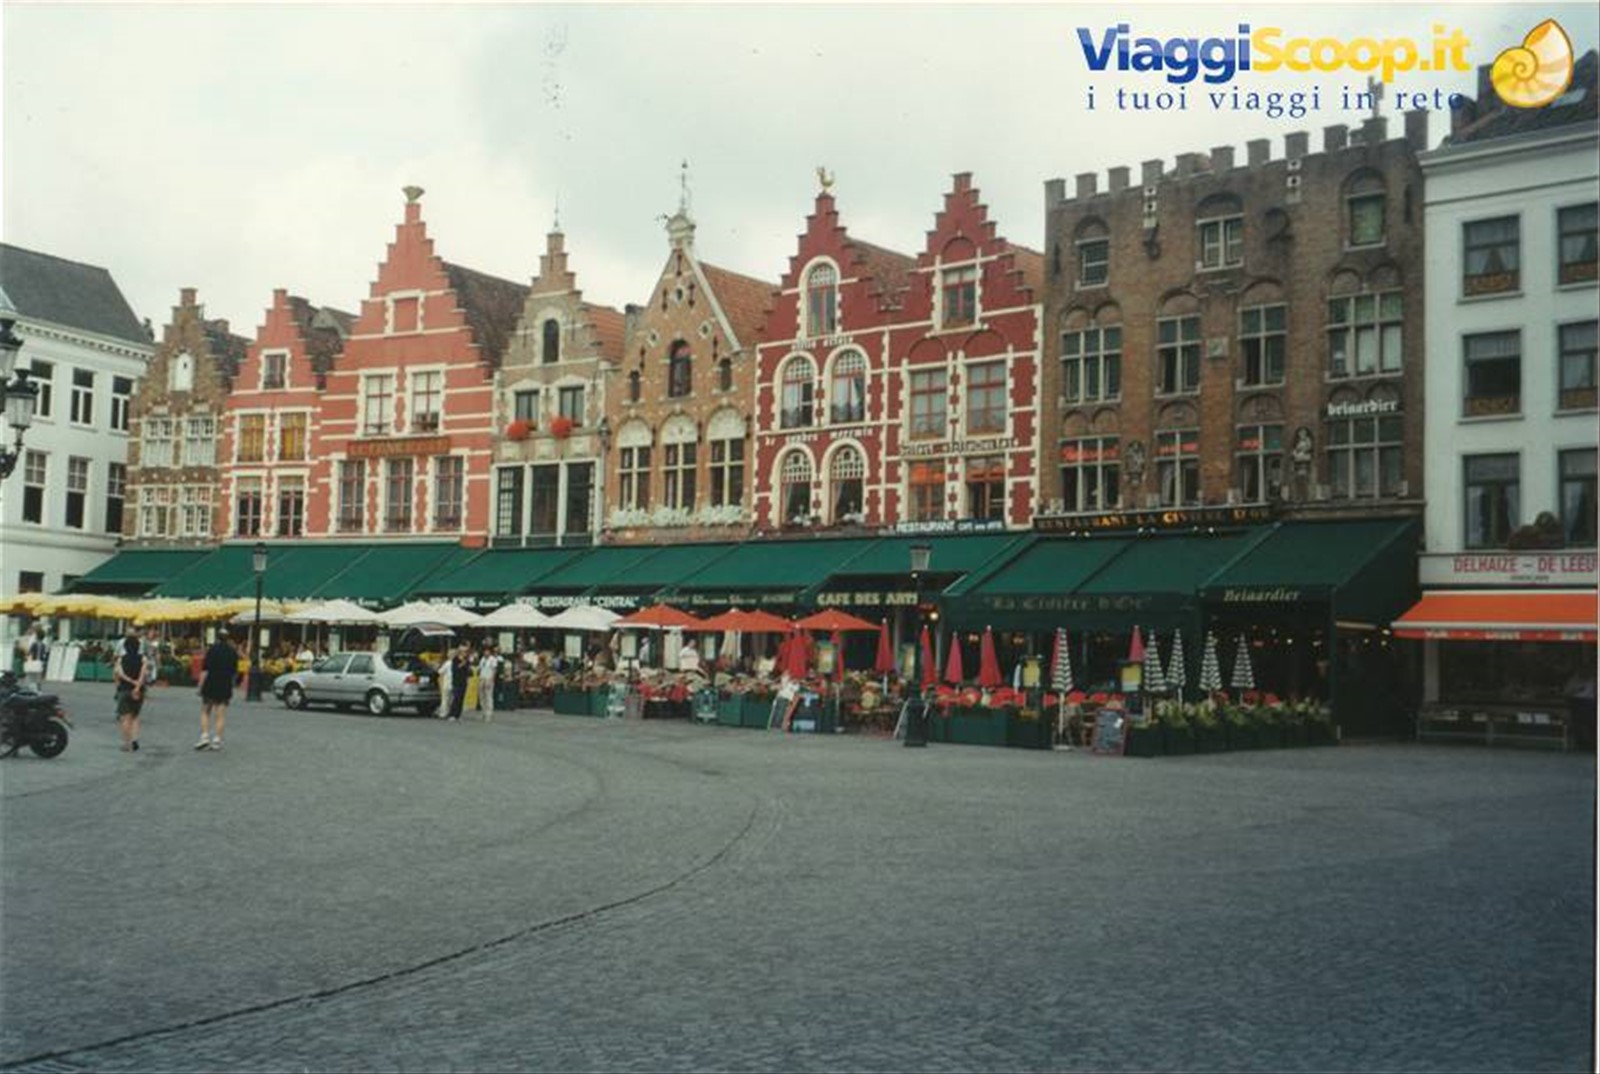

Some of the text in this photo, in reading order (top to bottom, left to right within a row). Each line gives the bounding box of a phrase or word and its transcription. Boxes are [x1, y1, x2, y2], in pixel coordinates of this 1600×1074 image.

[1453, 556, 1518, 573] DELHAIZE
[1538, 556, 1556, 572] DE
[854, 592, 880, 605] DES
[886, 592, 919, 605] ARTS
